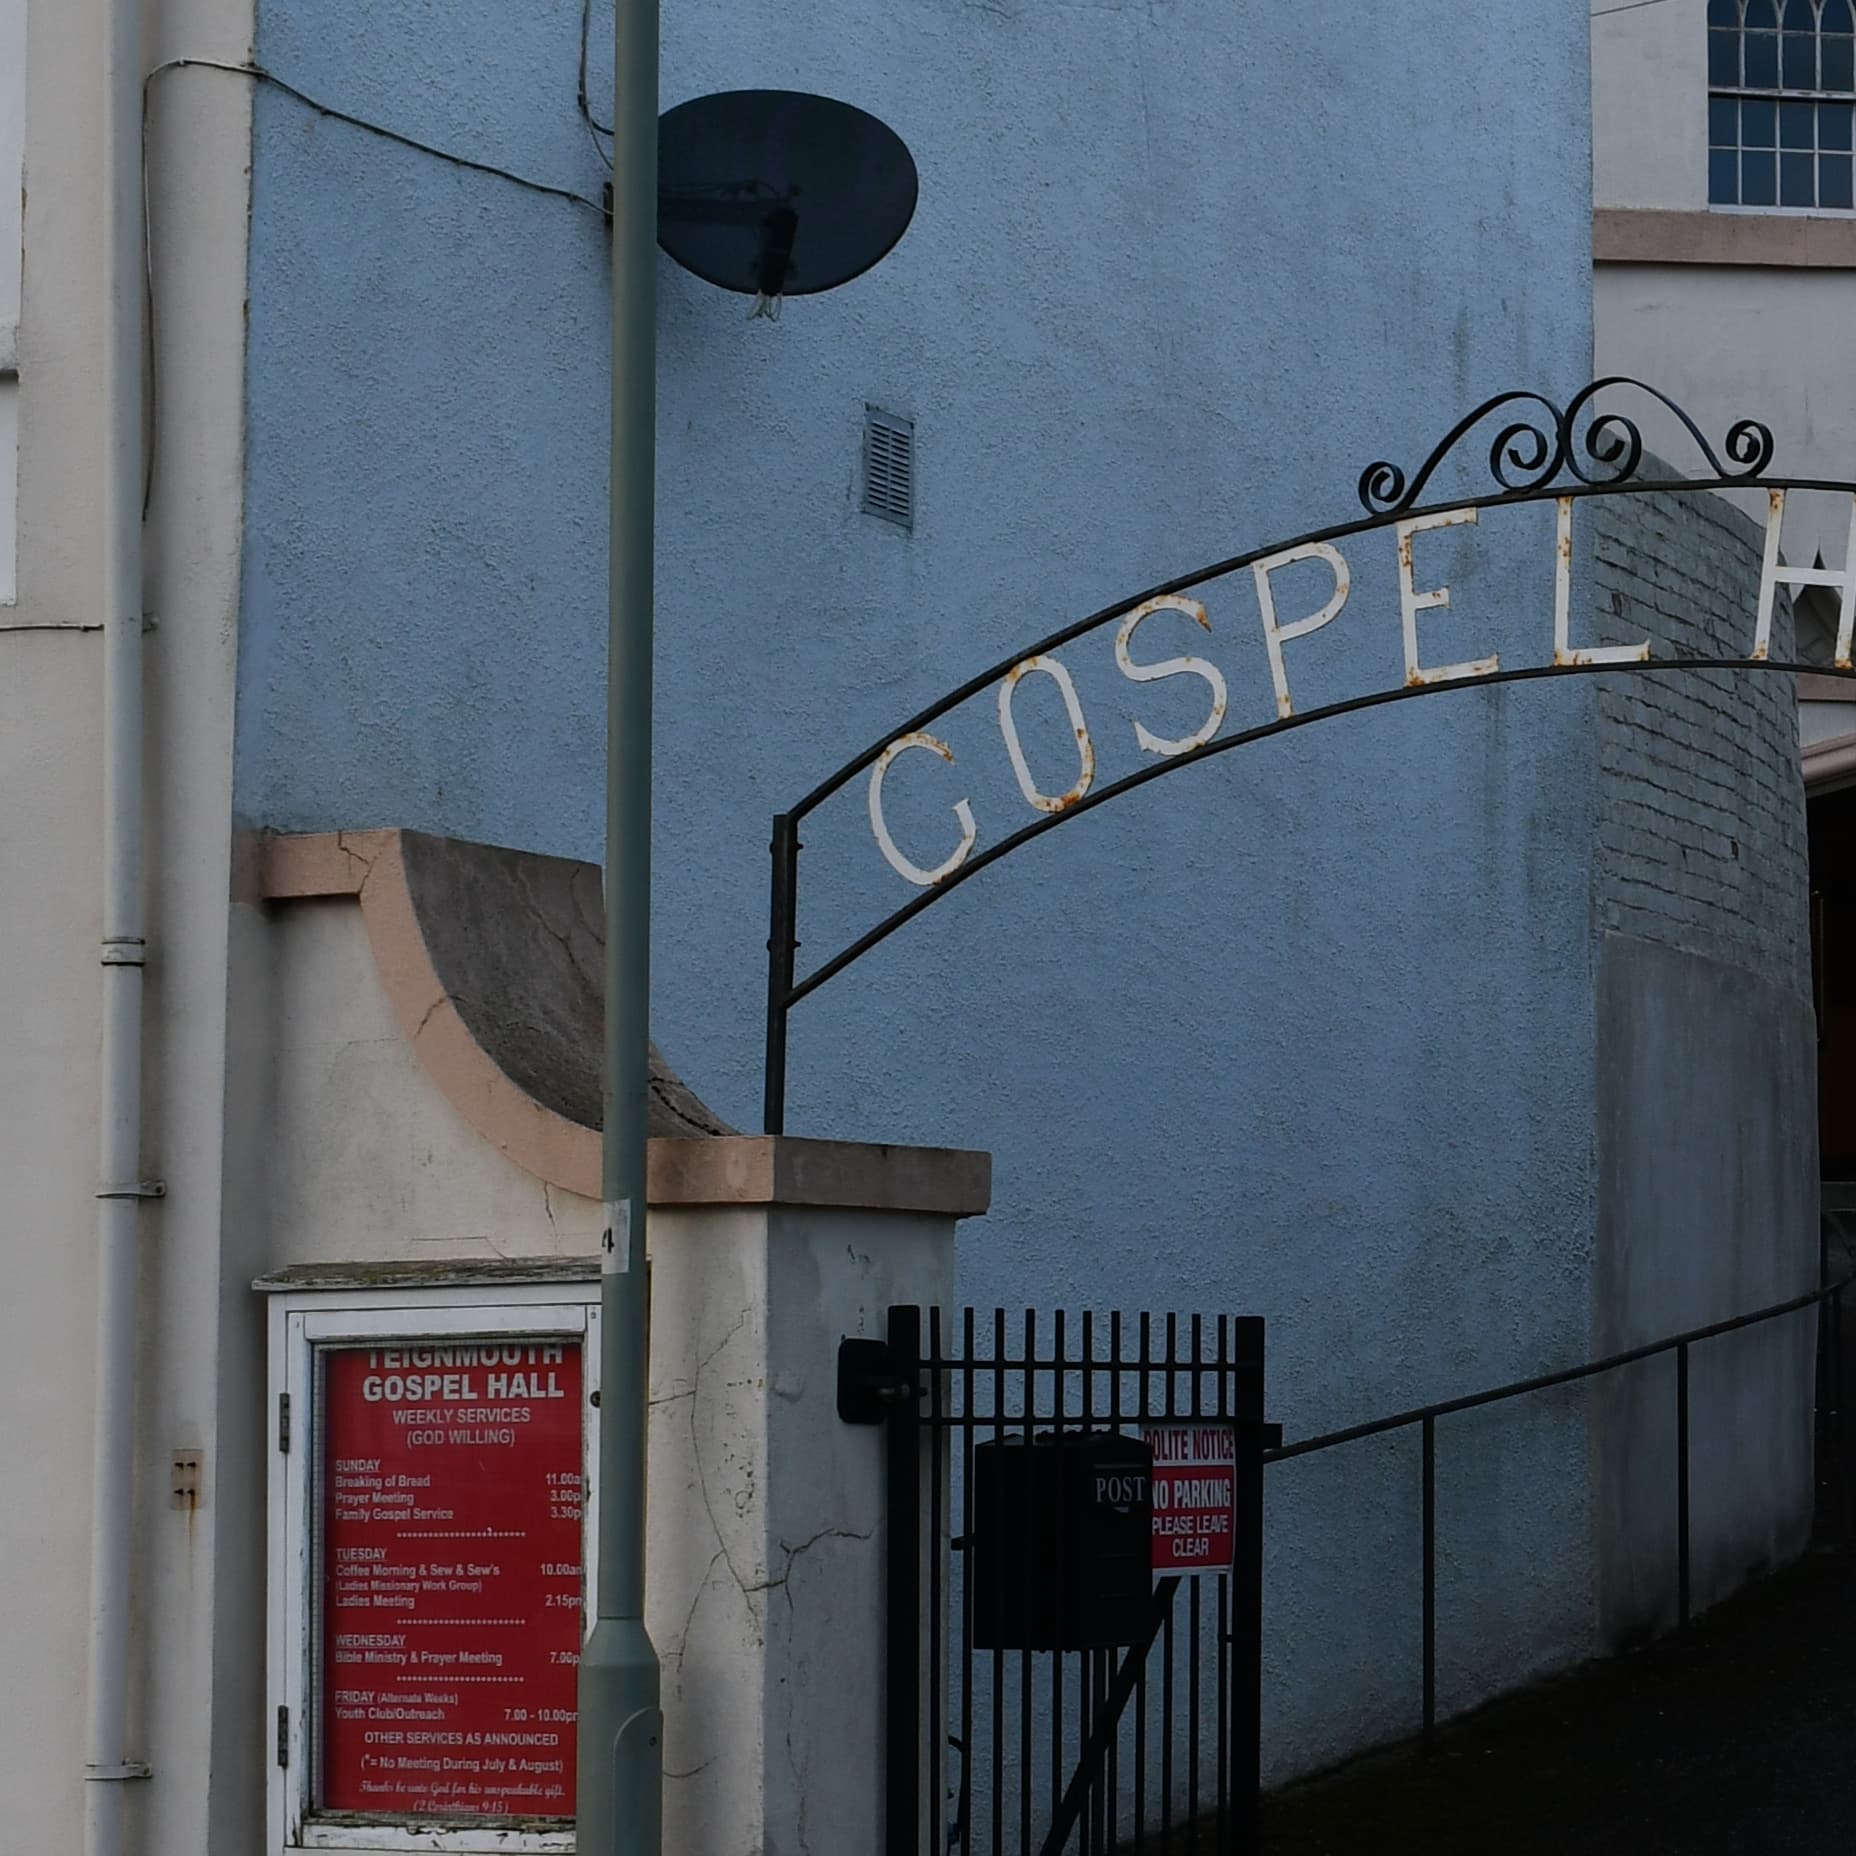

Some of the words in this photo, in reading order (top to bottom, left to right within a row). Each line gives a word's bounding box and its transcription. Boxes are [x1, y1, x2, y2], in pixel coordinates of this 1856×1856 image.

[866, 491, 1654, 888] GOSPEL
[367, 1344, 564, 1369] TEIGNMOUTH
[362, 1375, 479, 1401] GOSPEL
[487, 1372, 565, 1399] HALL
[393, 1409, 454, 1424] WEEKLY
[456, 1407, 531, 1423] SERVICES
[407, 1429, 444, 1448] (GOD
[448, 1428, 516, 1447] WILLING)
[1144, 1429, 1188, 1461] POLITE
[1193, 1429, 1234, 1460] NOTICE
[335, 1459, 381, 1472] SUNDAY
[335, 1475, 382, 1490] Breaking
[384, 1474, 397, 1487] of
[398, 1474, 432, 1487] Bread
[545, 1472, 582, 1486] 11.00a
[1095, 1476, 1146, 1503] POST
[335, 1492, 371, 1507] Prayer
[372, 1491, 415, 1506] Meeting
[550, 1489, 582, 1504] 3.00p
[1152, 1479, 1169, 1510] NO
[1173, 1478, 1231, 1509] PARKING
[335, 1508, 371, 1523] Family
[372, 1508, 412, 1523] Gospel
[413, 1507, 454, 1520] Service
[551, 1505, 582, 1520] 3.30p
[1152, 1515, 1194, 1536] PLEASE
[1196, 1515, 1229, 1534] LEAVE
[336, 1547, 387, 1561] TUESDAY
[1172, 1537, 1209, 1558] CLEAR
[336, 1564, 371, 1577] Coffee
[372, 1564, 416, 1579] Morning
[418, 1564, 428, 1576] &
[430, 1564, 453, 1576] Sew
[455, 1564, 465, 1576] &
[467, 1563, 500, 1576] Sew's
[336, 1580, 369, 1593] (Ladies
[370, 1580, 420, 1593] Missionary
[422, 1580, 447, 1591] Work
[449, 1579, 482, 1593] Group)
[336, 1595, 371, 1608] Ladies
[372, 1594, 415, 1609] Meeting
[335, 1634, 406, 1648] WEDNESDAY
[335, 1651, 363, 1664] Bible
[364, 1651, 408, 1666] Ministry
[410, 1651, 419, 1663] &
[421, 1651, 457, 1666] Prayer
[458, 1651, 503, 1666] Meeting
[550, 1651, 580, 1666] 7.00p
[335, 1691, 375, 1705] FRIDAY
[377, 1692, 422, 1705] (Alternate
[424, 1693, 458, 1706] Weeks)
[335, 1707, 365, 1720] Youth
[368, 1707, 445, 1720] Club/Outreach
[503, 1708, 528, 1721] 7.00
[364, 1731, 404, 1744] OTHER
[406, 1732, 463, 1745] SERVICES
[465, 1732, 482, 1745] AS
[483, 1732, 559, 1746] ANNOUNCED
[380, 1756, 396, 1769] No
[397, 1756, 441, 1772] Meeting
[443, 1757, 480, 1772] During
[482, 1757, 506, 1772] July
[507, 1758, 517, 1771] &
[519, 1758, 565, 1774] August)
